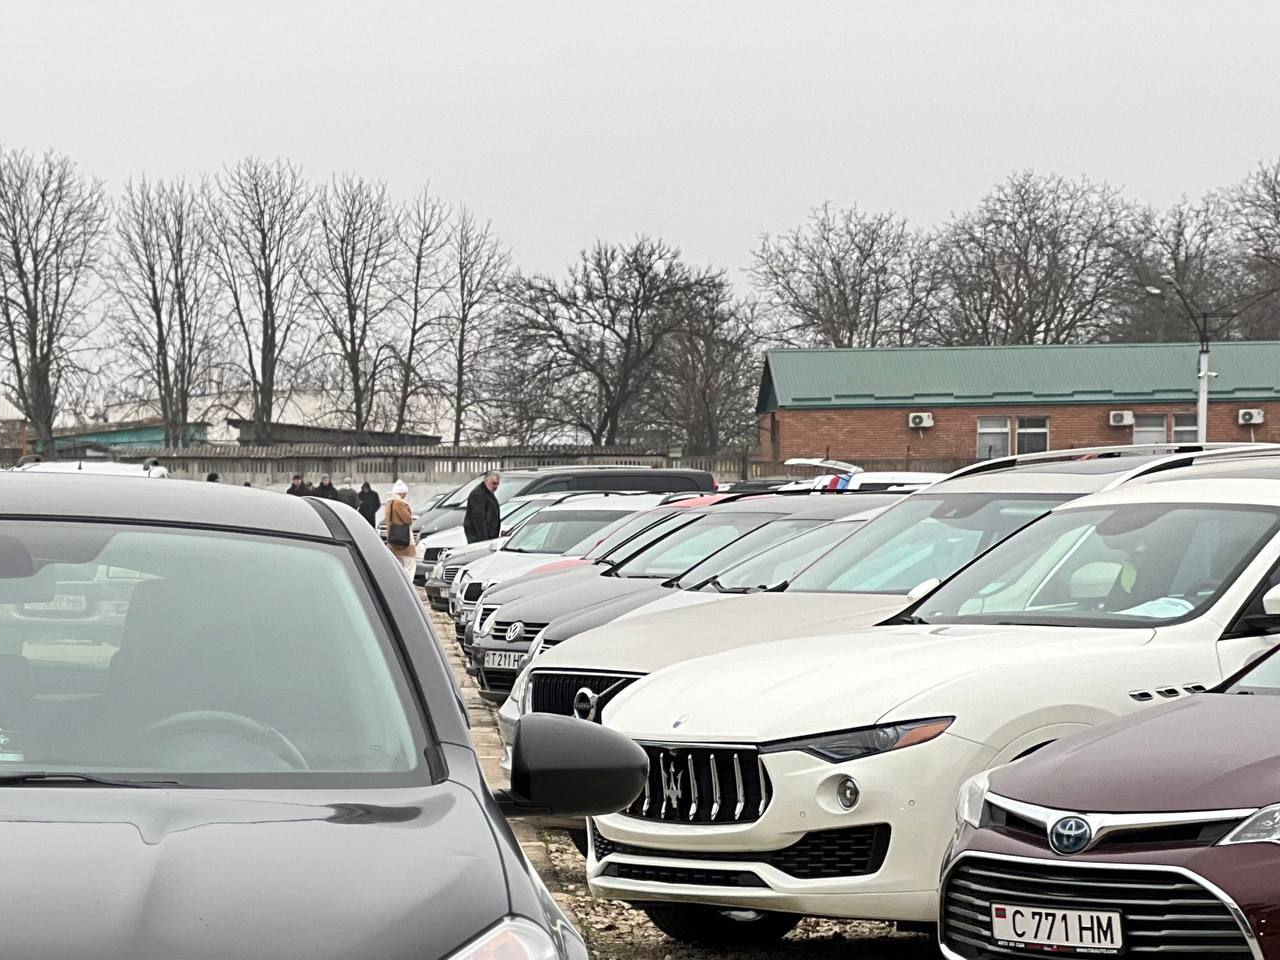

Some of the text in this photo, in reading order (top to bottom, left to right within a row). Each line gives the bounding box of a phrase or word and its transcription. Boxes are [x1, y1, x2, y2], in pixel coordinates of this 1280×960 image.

[492, 653, 497, 666] T
[497, 653, 511, 667] 211
[1012, 910, 1114, 944] C 771 HM
